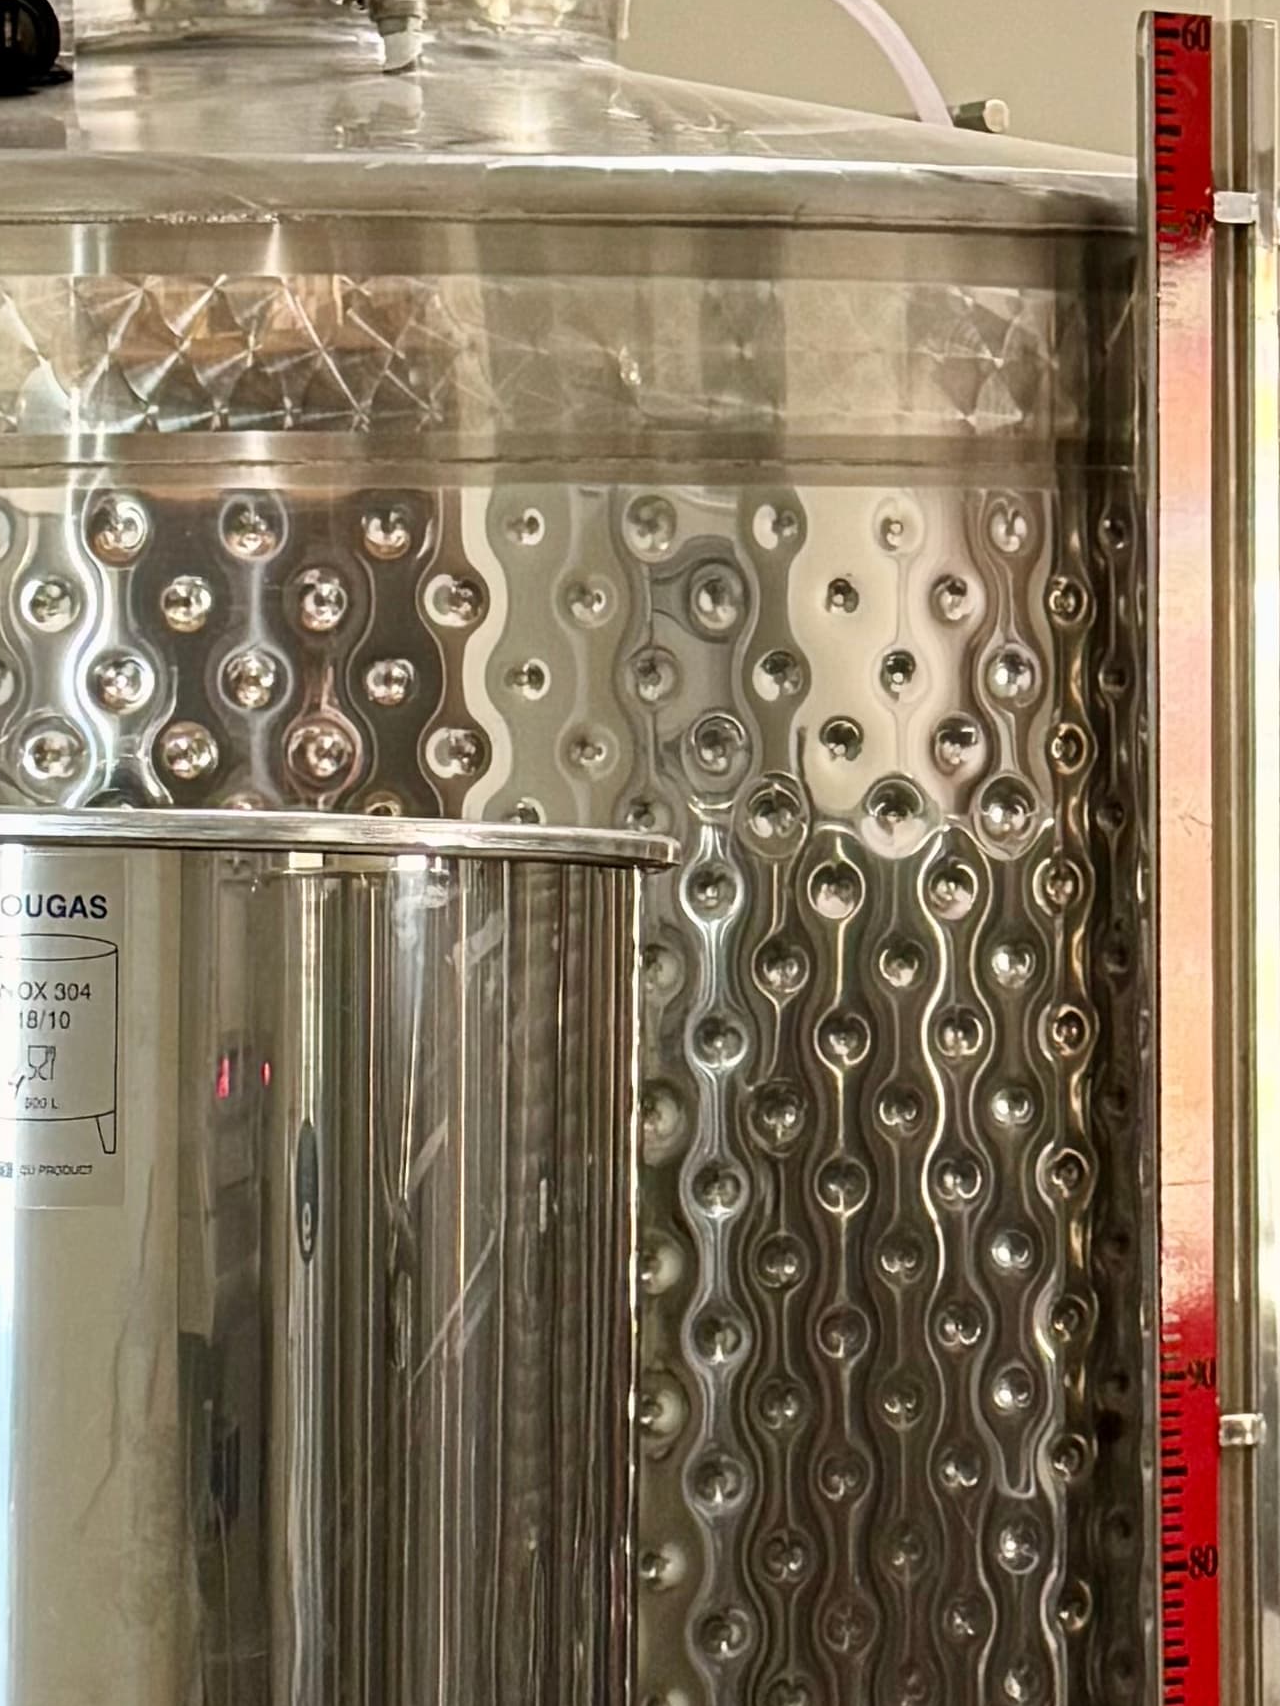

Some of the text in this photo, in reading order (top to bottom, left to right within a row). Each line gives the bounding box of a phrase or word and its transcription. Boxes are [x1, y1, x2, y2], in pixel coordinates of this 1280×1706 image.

[54, 982, 91, 1001] 304
[19, 1010, 71, 1030] 18/10
[1188, 1359, 1216, 1391] 90
[1189, 1545, 1218, 1580] 80
